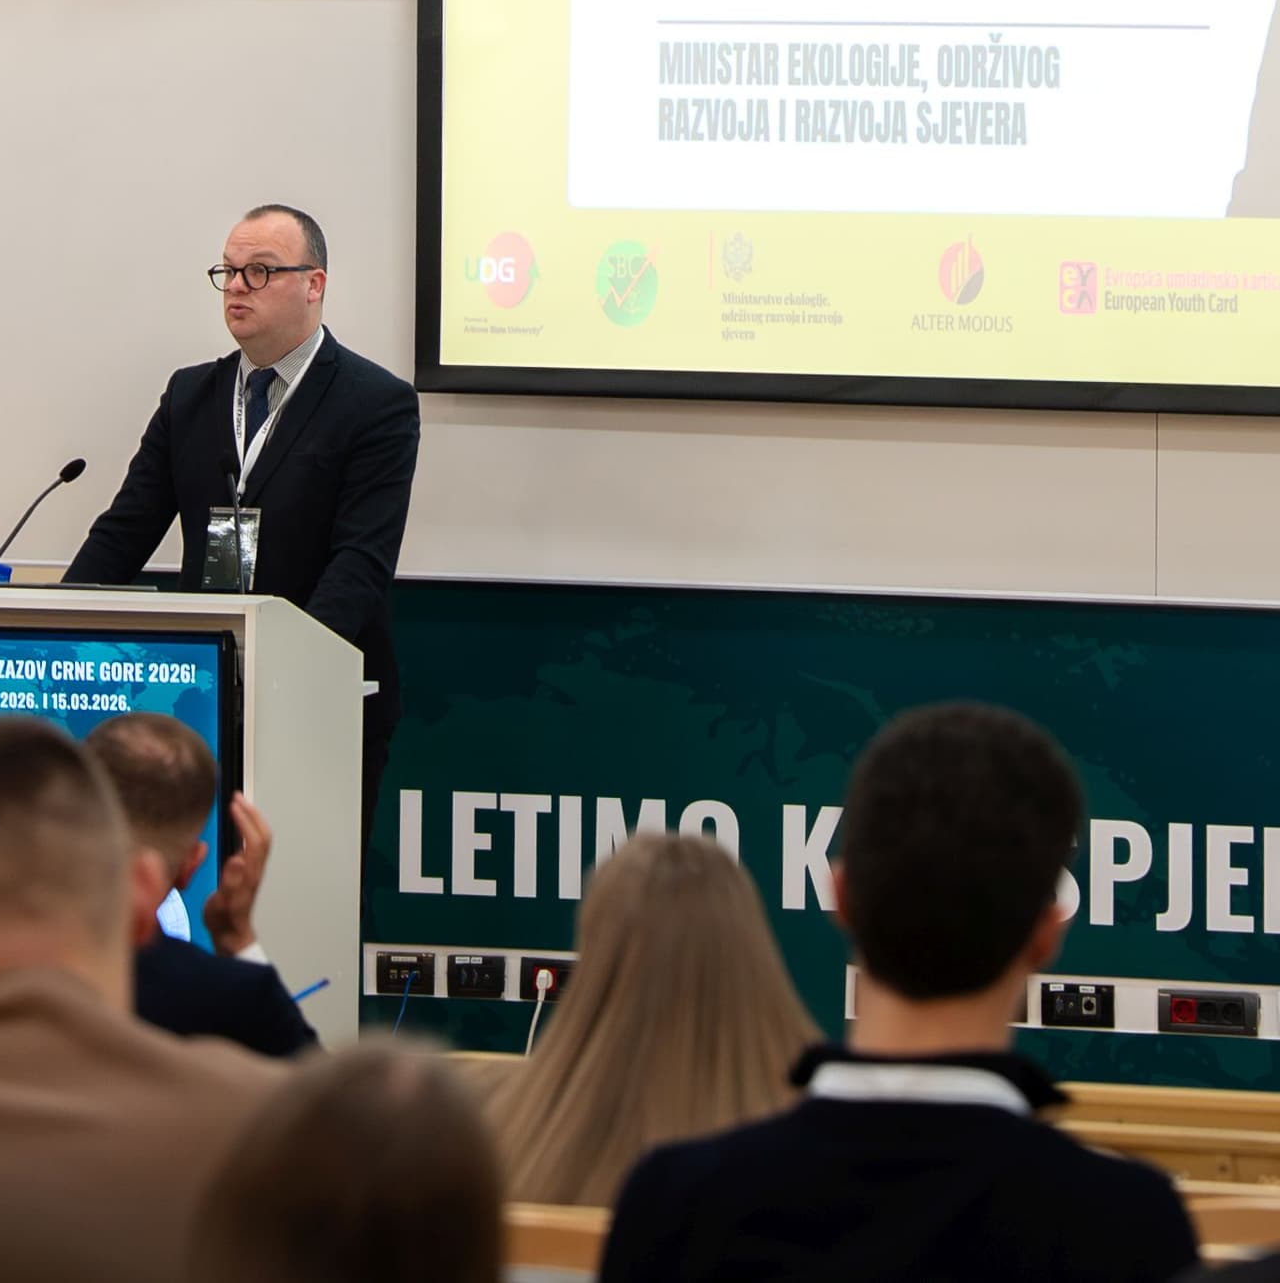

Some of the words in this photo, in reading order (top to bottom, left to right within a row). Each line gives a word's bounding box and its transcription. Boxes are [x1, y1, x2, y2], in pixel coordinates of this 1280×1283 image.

[658, 42, 780, 88] MINISTAR
[787, 42, 929, 94] EKOLOGIJE,
[936, 32, 1061, 90] ODRŽIVOG
[658, 97, 771, 143] RAZVOJA
[778, 100, 788, 144] I
[795, 100, 908, 145] RAZVOJA
[916, 101, 1028, 146] SJEVERA
[463, 256, 516, 284] UDG
[1104, 266, 1163, 288] Evropska
[721, 292, 782, 305] Ministarstvo
[1104, 290, 1166, 314] European
[1168, 292, 1206, 313] Youth
[1208, 293, 1239, 313] Card
[910, 314, 955, 332] ALTER
[958, 315, 1014, 334] MODUS
[51, 660, 97, 682] CRNE
[99, 661, 144, 684] GORE
[147, 662, 197, 685] 2026!
[51, 692, 131, 712] 15.03.2026.
